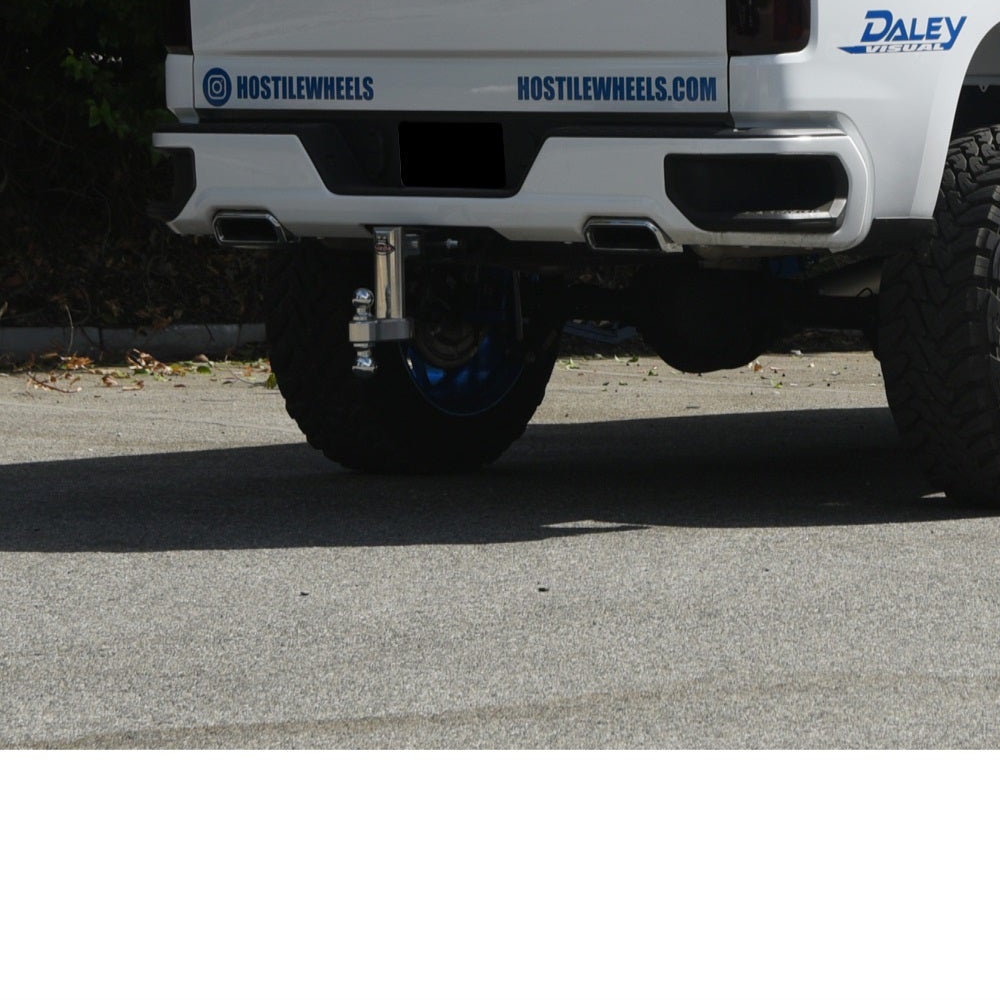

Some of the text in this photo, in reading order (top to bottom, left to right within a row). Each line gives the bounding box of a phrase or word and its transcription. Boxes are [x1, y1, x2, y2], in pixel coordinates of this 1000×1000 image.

[865, 43, 945, 54] VISUAL
[236, 75, 375, 101] HOSTILEWHEELS
[517, 75, 717, 101] HOSTILEWHEELS.COM
